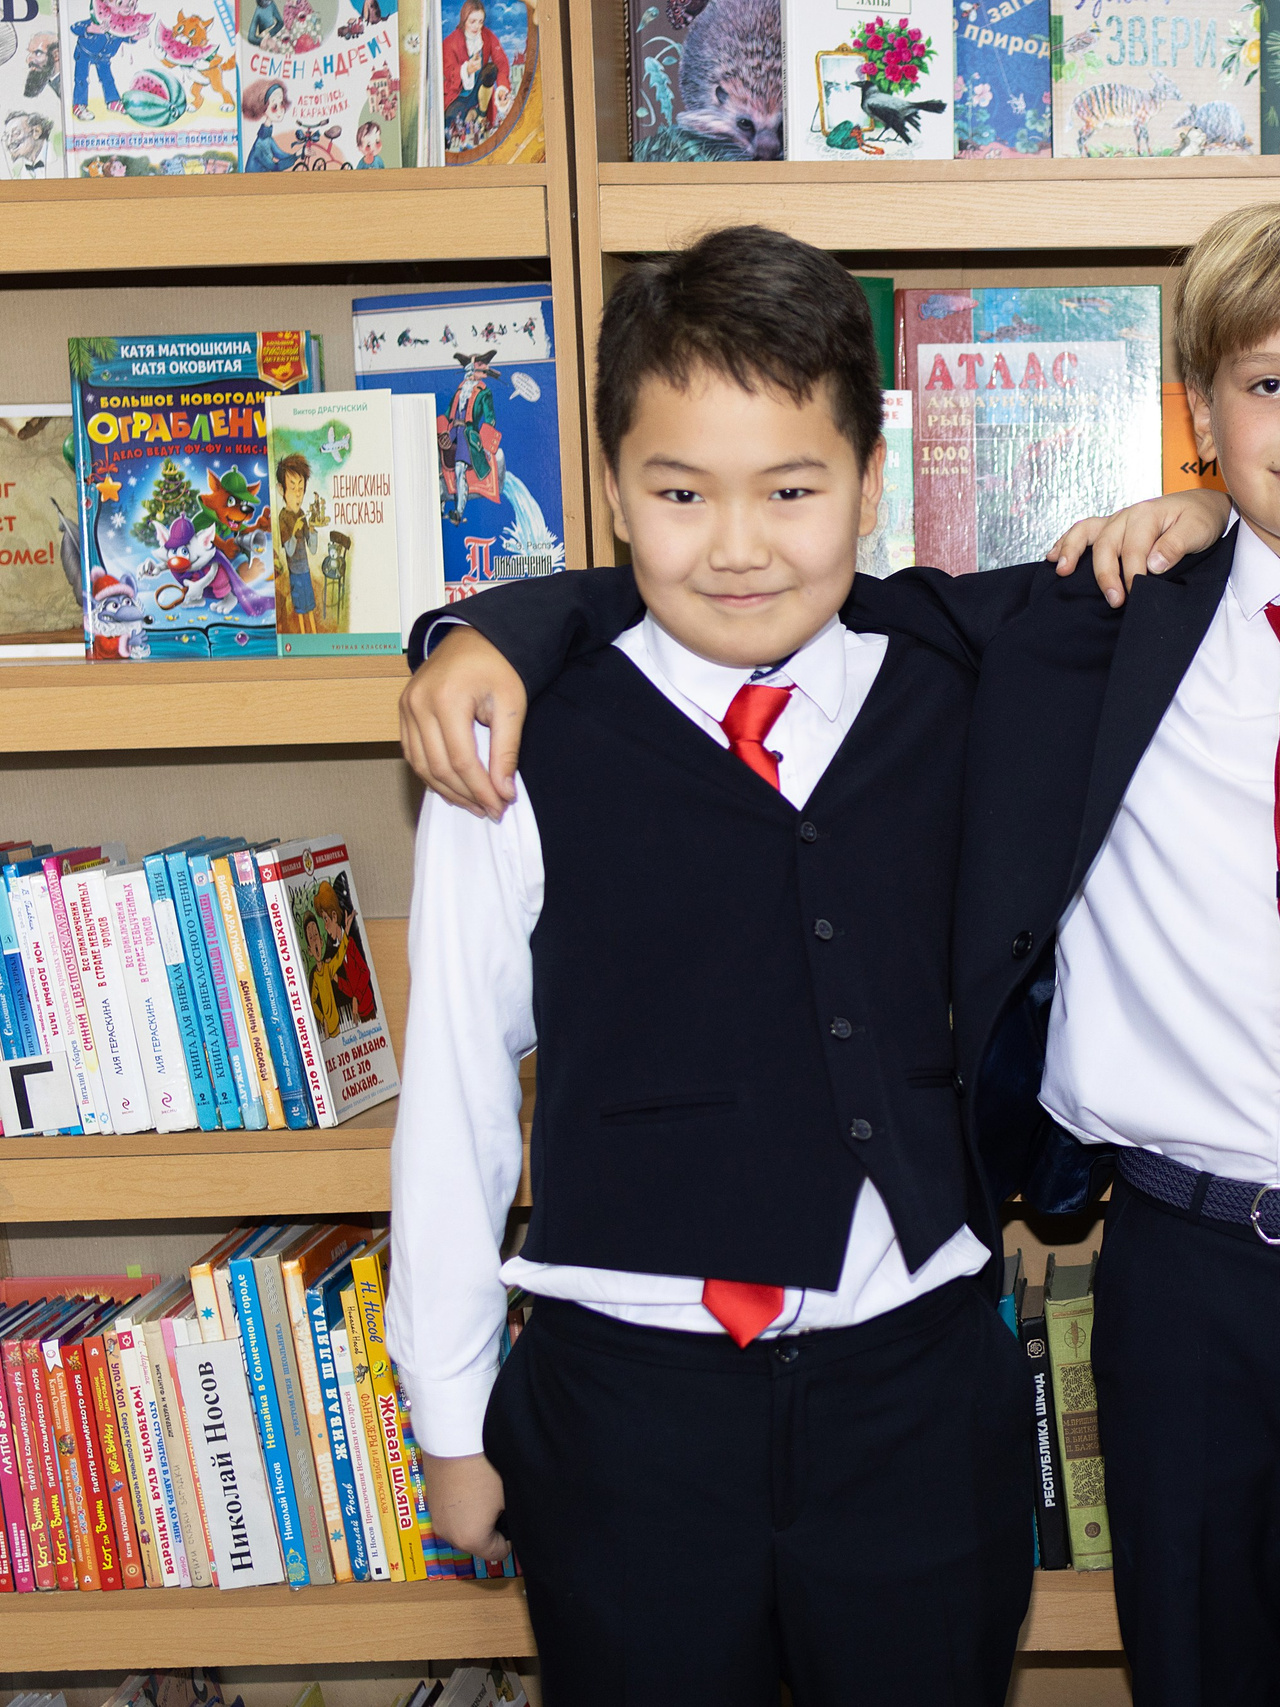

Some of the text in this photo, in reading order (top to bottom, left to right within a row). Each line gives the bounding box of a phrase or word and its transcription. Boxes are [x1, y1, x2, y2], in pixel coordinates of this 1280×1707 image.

[250, 54, 305, 80] СЕМЁН
[1104, 14, 1219, 69] ЗВЕРИ
[121, 340, 252, 359] КАТЯ МАТЮШКИНА
[132, 359, 242, 376] КАТЯ ОКОВИТАЯ
[924, 351, 1079, 392] АТЛАС
[100, 394, 174, 409] БОЛЬШОЕ
[292, 402, 368, 416] Виктор ДРАГУНСКИЙ
[927, 414, 974, 429] РЫБ
[332, 473, 391, 500] ДЕНИСКИНЫ
[921, 446, 970, 461] 1000
[334, 501, 384, 525] РАССКАЗЫ
[98, 916, 113, 949] УРОКОВ
[142, 916, 155, 947] УРОКОВ
[217, 874, 247, 973] ВИКТОР ДРАГУНСКИЙ
[32, 940, 60, 1037] МОЙ ДОБРЫЙ ПАПА
[46, 868, 94, 1052] СИНИЙ ЦВЕТОЧЕК ДЛЯ МАМЫ
[176, 870, 226, 1079] КНИГА ДЛЯ ВНЕКЛАССНОГО ЧТЕНИЯ
[100, 998, 125, 1076] ЛИЯ ГЕРАСКИНА
[144, 996, 166, 1075] ЛИЯ ГЕРАСКИНА
[240, 980, 268, 1082] ДЕНИСКИНЫ РАССКАЗЫ
[9, 1060, 54, 1130] Г
[342, 1060, 372, 1083] ГДЕ ЭТО
[360, 1281, 384, 1345] Н. Носов
[236, 1274, 277, 1450] Незнайка в Солнечном городе
[275, 1322, 301, 1437] ХРЕСТОМАТИЯ ШКОЛЬНИКА
[312, 1304, 349, 1461] ЖИВАЯ ШЛЯПА
[198, 1361, 229, 1444] Носов
[377, 1392, 402, 1463] Живая
[120, 1412, 147, 1525] Секрет крошечных человечков
[1035, 1373, 1056, 1508] РЕСПУБЛИКА ШКИД
[213, 1452, 255, 1573] Николай
[271, 1462, 295, 1541] Николай Носов
[388, 1468, 413, 1531] шляпа
[408, 1446, 426, 1512] Николай Носов
[342, 1482, 367, 1569] Николай Носов
[179, 1556, 188, 1579] ОНИКС
